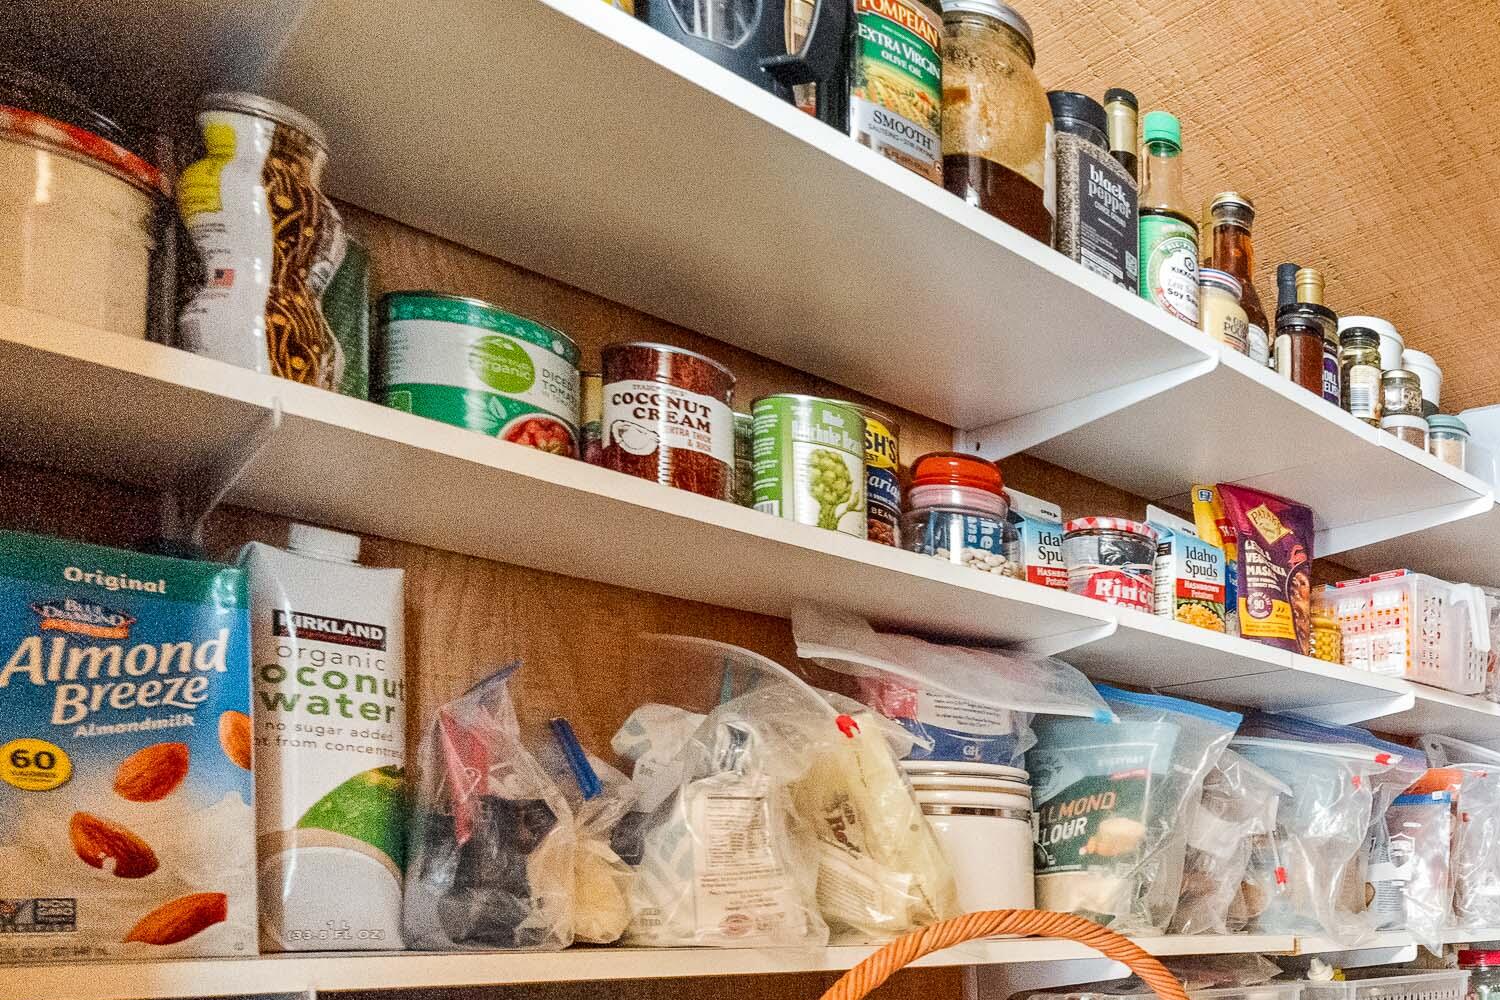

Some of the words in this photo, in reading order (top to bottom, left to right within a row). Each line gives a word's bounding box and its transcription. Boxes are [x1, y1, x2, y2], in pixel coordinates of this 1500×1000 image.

[858, 23, 901, 55] EXTRA
[902, 43, 940, 79] VIRGIN
[873, 110, 931, 150] SMOOTH
[1090, 164, 1128, 205] black
[1088, 180, 1131, 219] pepper
[612, 392, 712, 418] COCONUT
[632, 407, 711, 434] CREAM
[864, 430, 896, 464] SH'S
[1038, 547, 1063, 565] Spu
[1185, 545, 1217, 565] Idaho
[63, 566, 167, 594] Original
[1185, 560, 1218, 579] Spuds
[279, 613, 385, 641] KIRKLAND
[0, 628, 229, 688] Almond
[277, 644, 387, 672] organic
[259, 663, 405, 701] oconut
[51, 676, 210, 726] Breeze
[258, 690, 396, 724] water
[74, 714, 195, 738] Almondmilk
[264, 721, 287, 731] no
[295, 724, 342, 736] sugar
[276, 735, 318, 749] from
[10, 749, 56, 770] 60
[1041, 817, 1088, 846] LOUR
